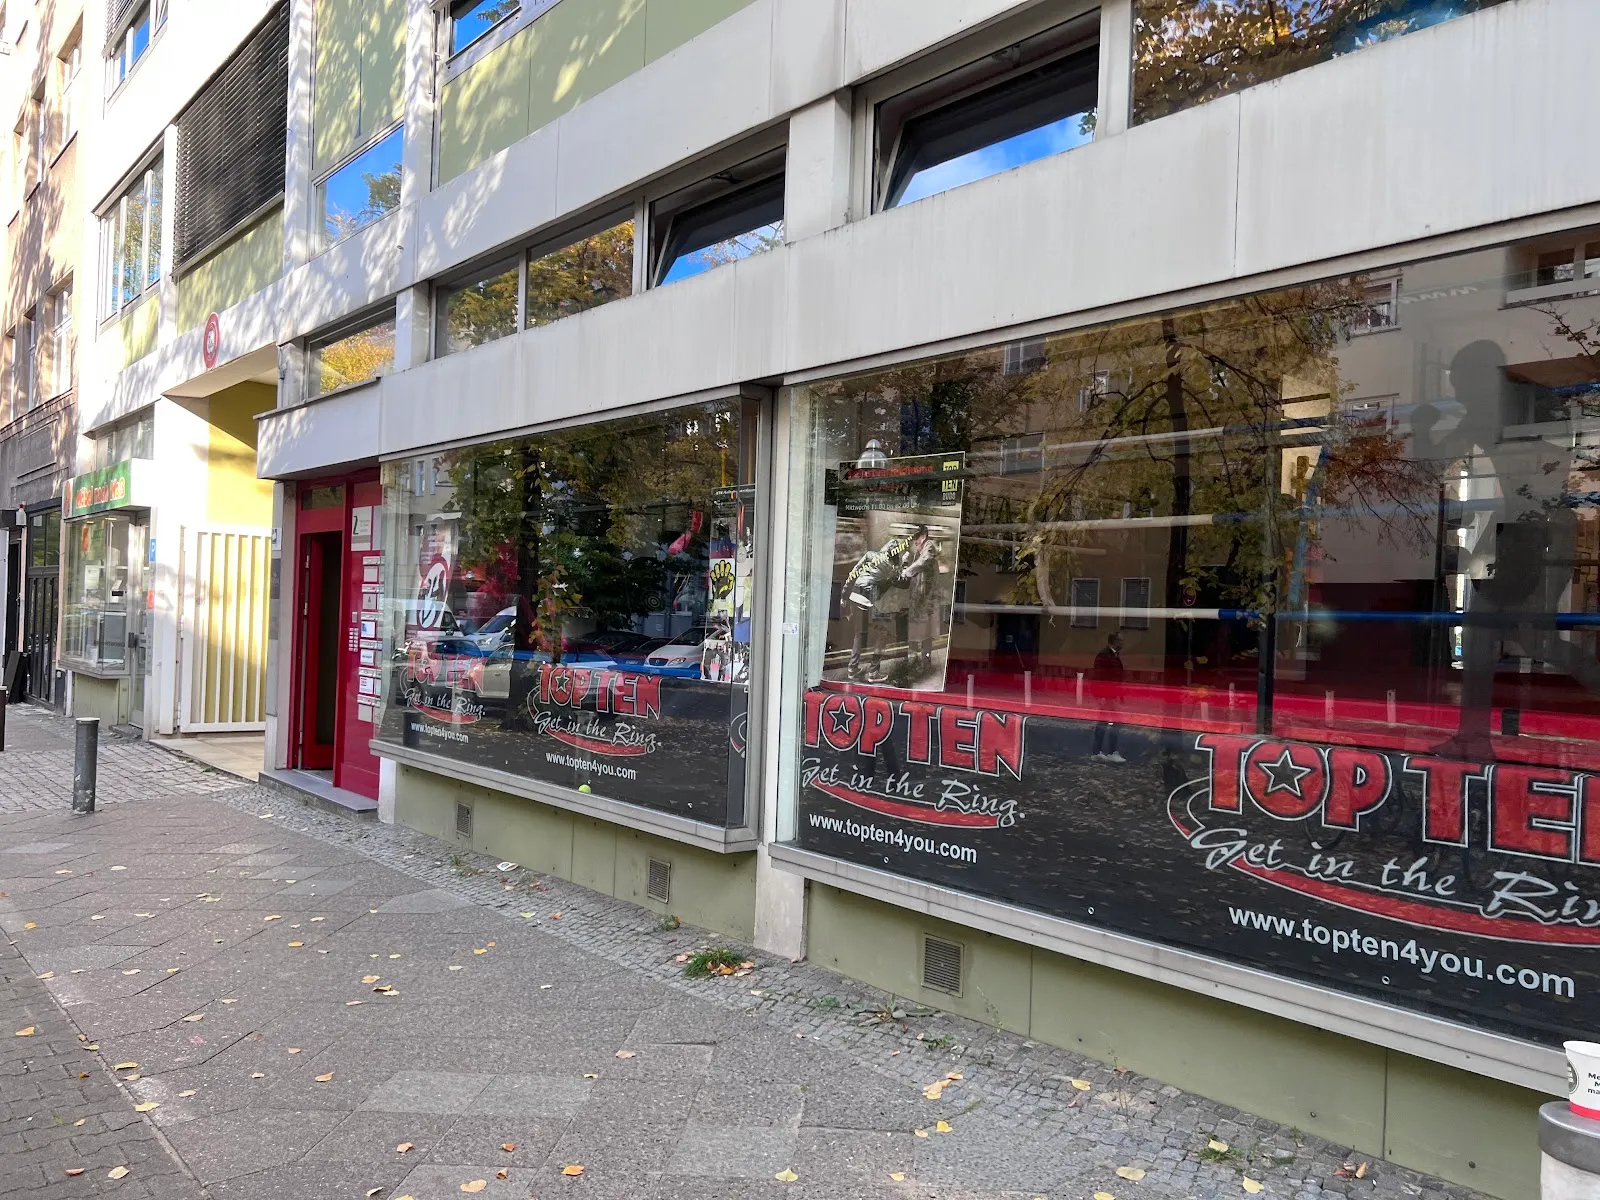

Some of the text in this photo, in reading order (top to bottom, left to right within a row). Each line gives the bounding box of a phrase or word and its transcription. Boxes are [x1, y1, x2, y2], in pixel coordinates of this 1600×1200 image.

[407, 650, 442, 686] TOP
[538, 663, 663, 720] TOP TEN
[405, 687, 486, 722] Get in the Ring.
[410, 721, 469, 744] www.topten4you.com
[534, 711, 662, 754] Get in the Ring.
[804, 691, 1027, 781] TOP TEN
[545, 751, 637, 780] www.topten4you.com
[1194, 733, 1393, 832] TOP
[801, 757, 1027, 829] Get in the Ring.
[808, 812, 978, 864] www.topten4you.com
[1190, 828, 1285, 871] Get
[1309, 841, 1354, 878] in
[1380, 856, 1456, 896] the
[1228, 905, 1576, 998] www.topten4you.com
